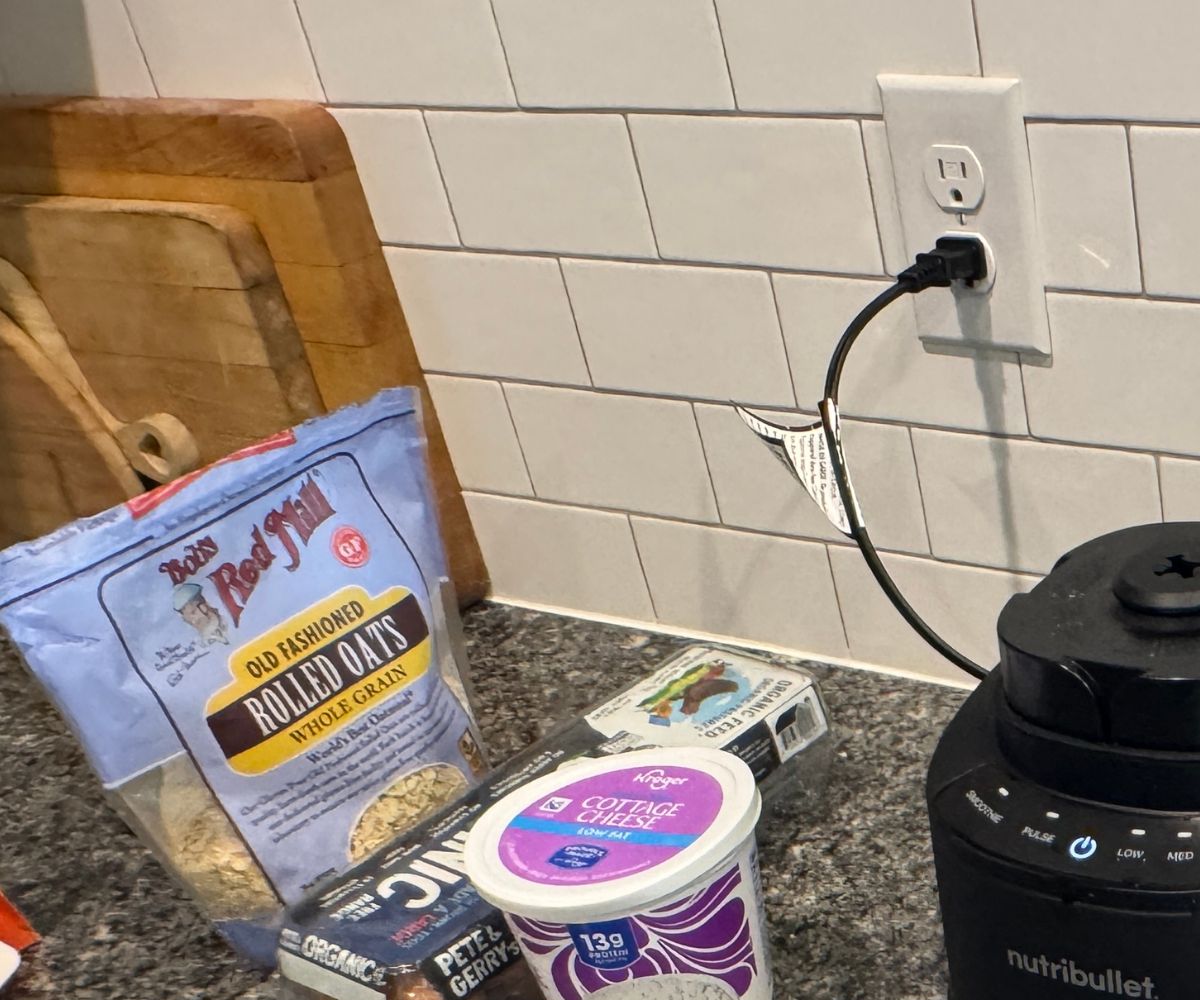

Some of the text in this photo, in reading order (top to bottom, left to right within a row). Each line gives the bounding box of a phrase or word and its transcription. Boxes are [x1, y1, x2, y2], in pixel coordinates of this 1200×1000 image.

[206, 523, 276, 628] Red
[246, 651, 280, 679] OLD
[276, 600, 365, 661] FASHIONED
[242, 654, 344, 737] ROLLED
[337, 615, 408, 677] OATS
[289, 664, 408, 744] WHOLE GRAIN
[741, 680, 793, 718] ORGANIC
[633, 769, 688, 790] Kroger
[576, 810, 659, 830] CHEESE
[581, 796, 684, 817] COTTAGE
[1020, 826, 1056, 844] PULSE
[1117, 848, 1146, 860] LOW
[1167, 851, 1194, 861] MED
[434, 930, 489, 977] PETE
[579, 932, 624, 951] 13g
[302, 934, 377, 982] ORGANIC
